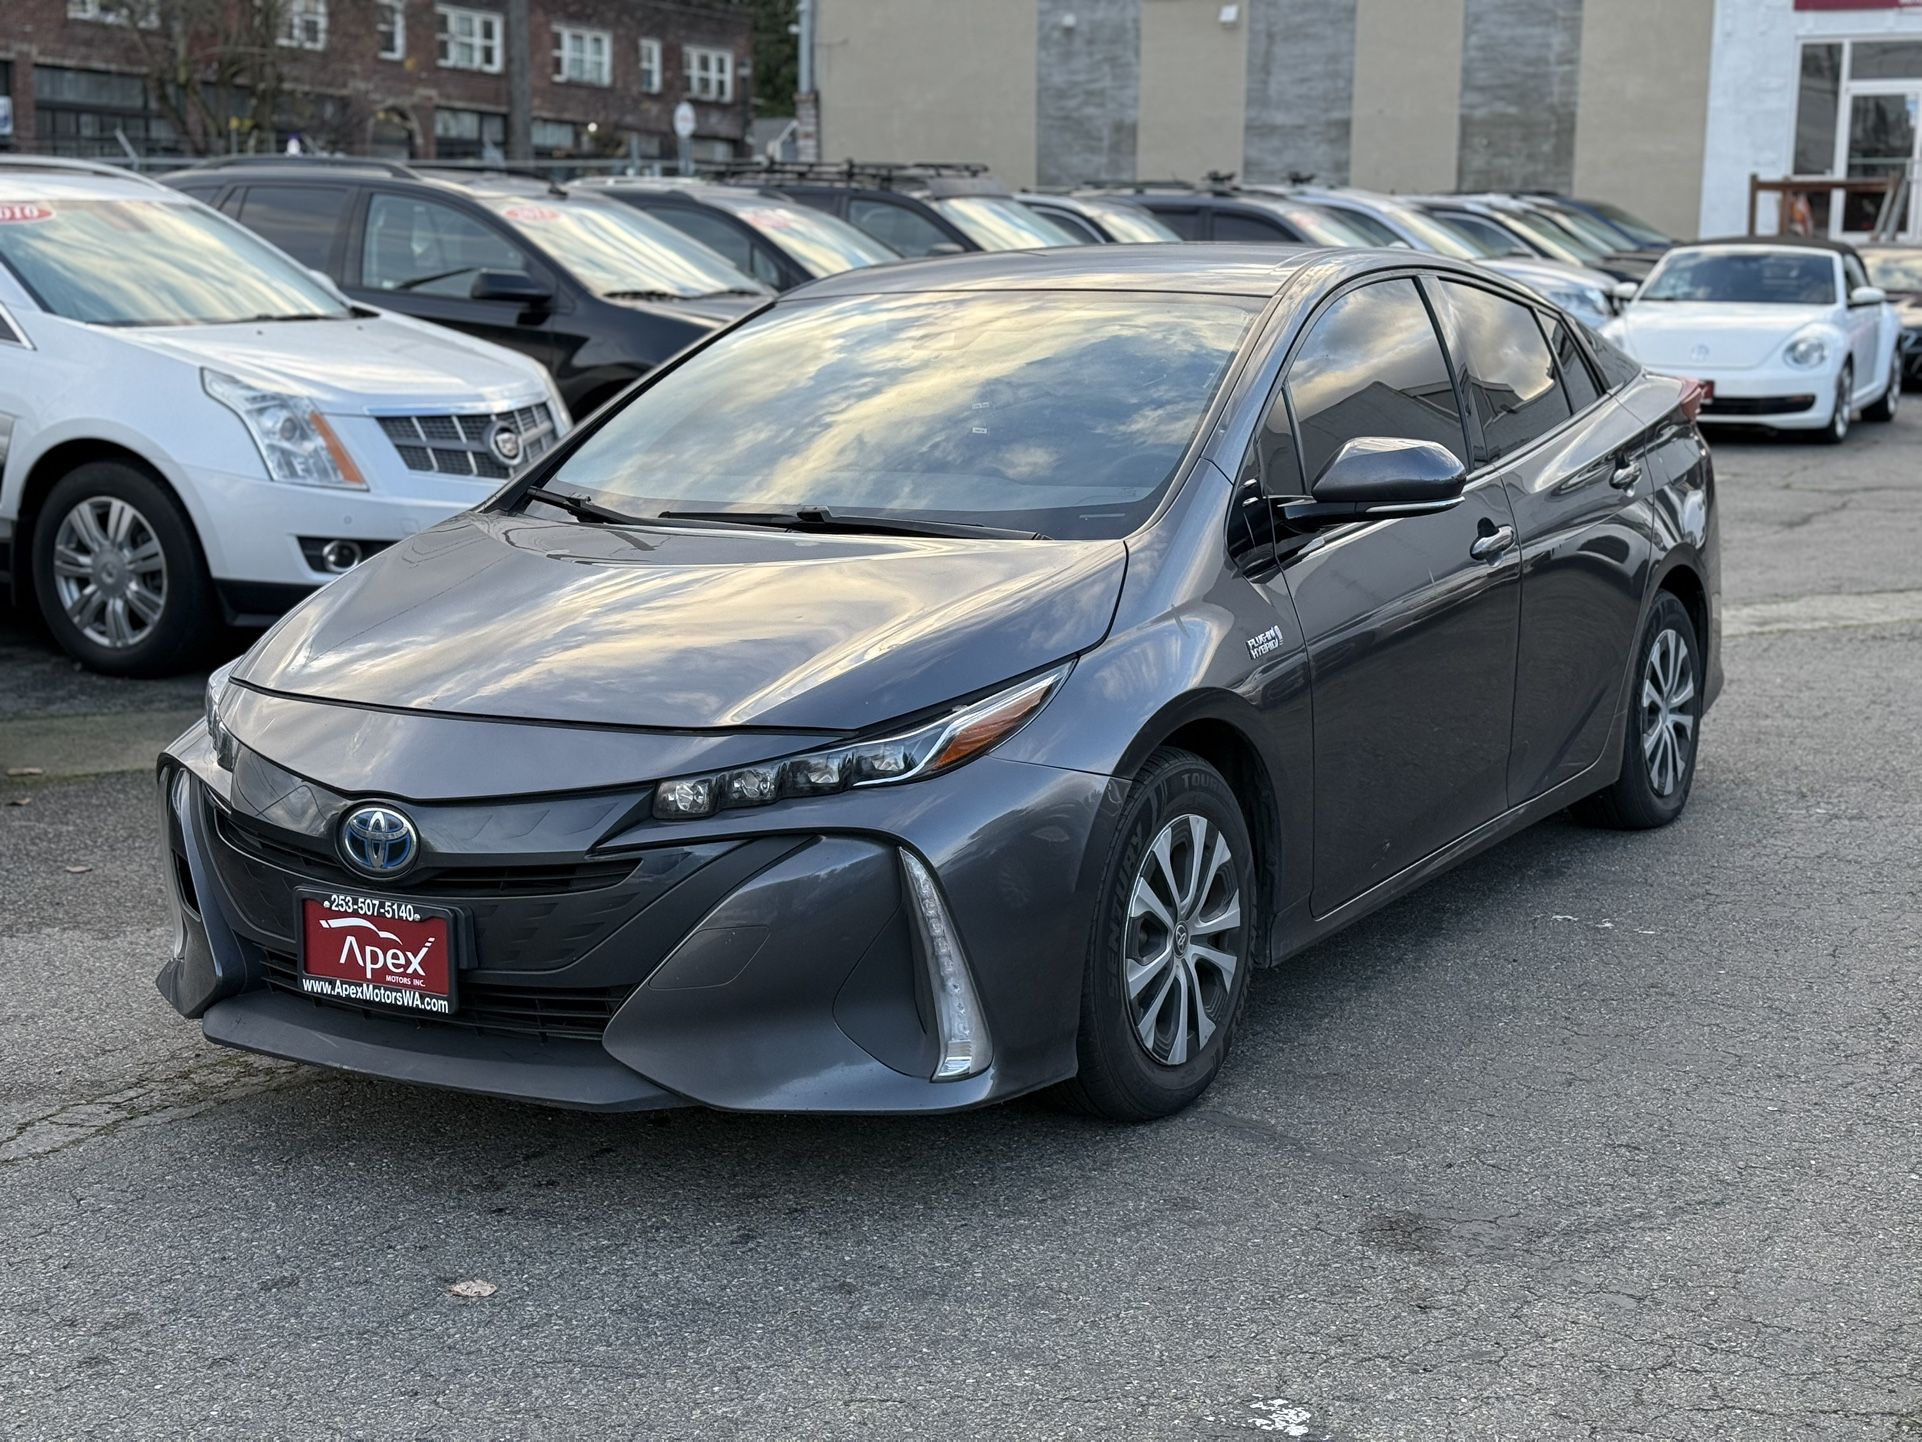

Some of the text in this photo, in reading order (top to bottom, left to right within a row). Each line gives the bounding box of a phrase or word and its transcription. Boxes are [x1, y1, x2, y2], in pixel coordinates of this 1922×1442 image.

[1250, 638, 1279, 659] HYBRID
[331, 894, 414, 922] 253-507-5140
[339, 935, 436, 979] Apex
[385, 974, 411, 985] MOTORS
[302, 979, 449, 1014] www.ApexMotorsWA.com
